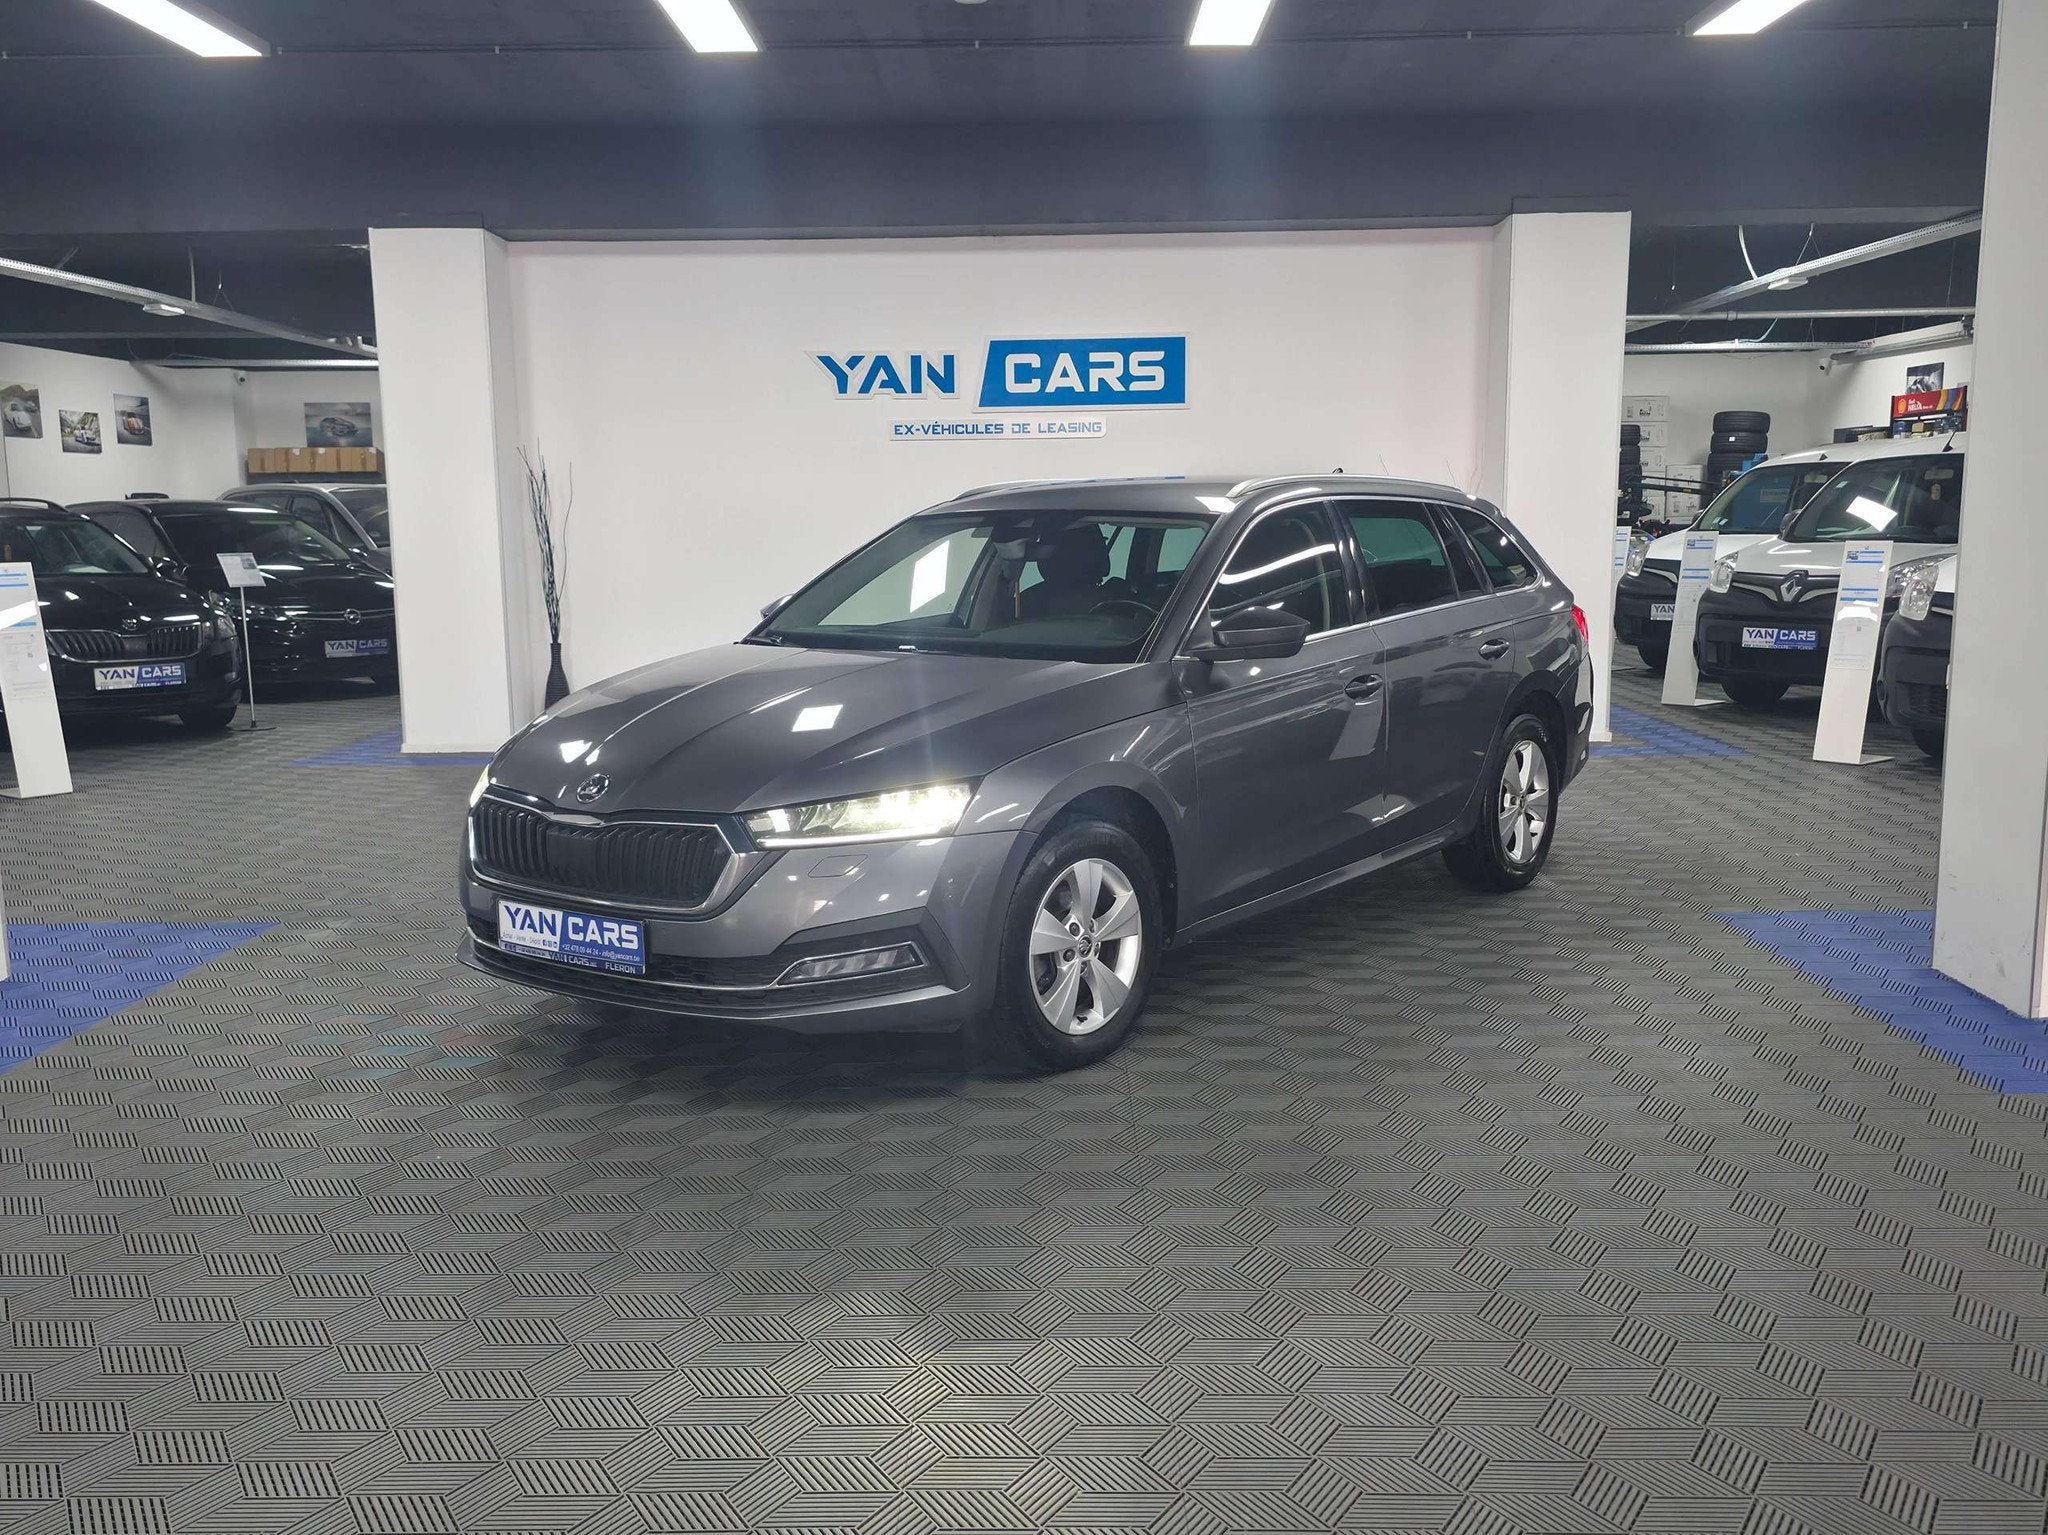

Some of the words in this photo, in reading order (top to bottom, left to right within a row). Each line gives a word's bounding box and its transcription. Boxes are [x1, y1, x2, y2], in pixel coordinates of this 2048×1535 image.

[815, 354, 955, 394] YAN
[1004, 350, 1165, 394] CARS
[893, 420, 1005, 435] EX-VÉHICULES
[1010, 422, 1032, 435] DE
[1037, 421, 1102, 434] LEASING
[1653, 605, 1675, 614] YAN
[1746, 629, 1775, 639] YAN
[1779, 630, 1816, 641] CARS
[328, 641, 355, 650] YAN
[358, 639, 388, 649] CARS
[98, 668, 135, 680] YAN
[141, 665, 182, 678] CARS
[503, 905, 557, 937] YAN
[567, 916, 638, 950] CARS
[568, 955, 590, 966] CARS
[605, 961, 636, 974] FLERON
